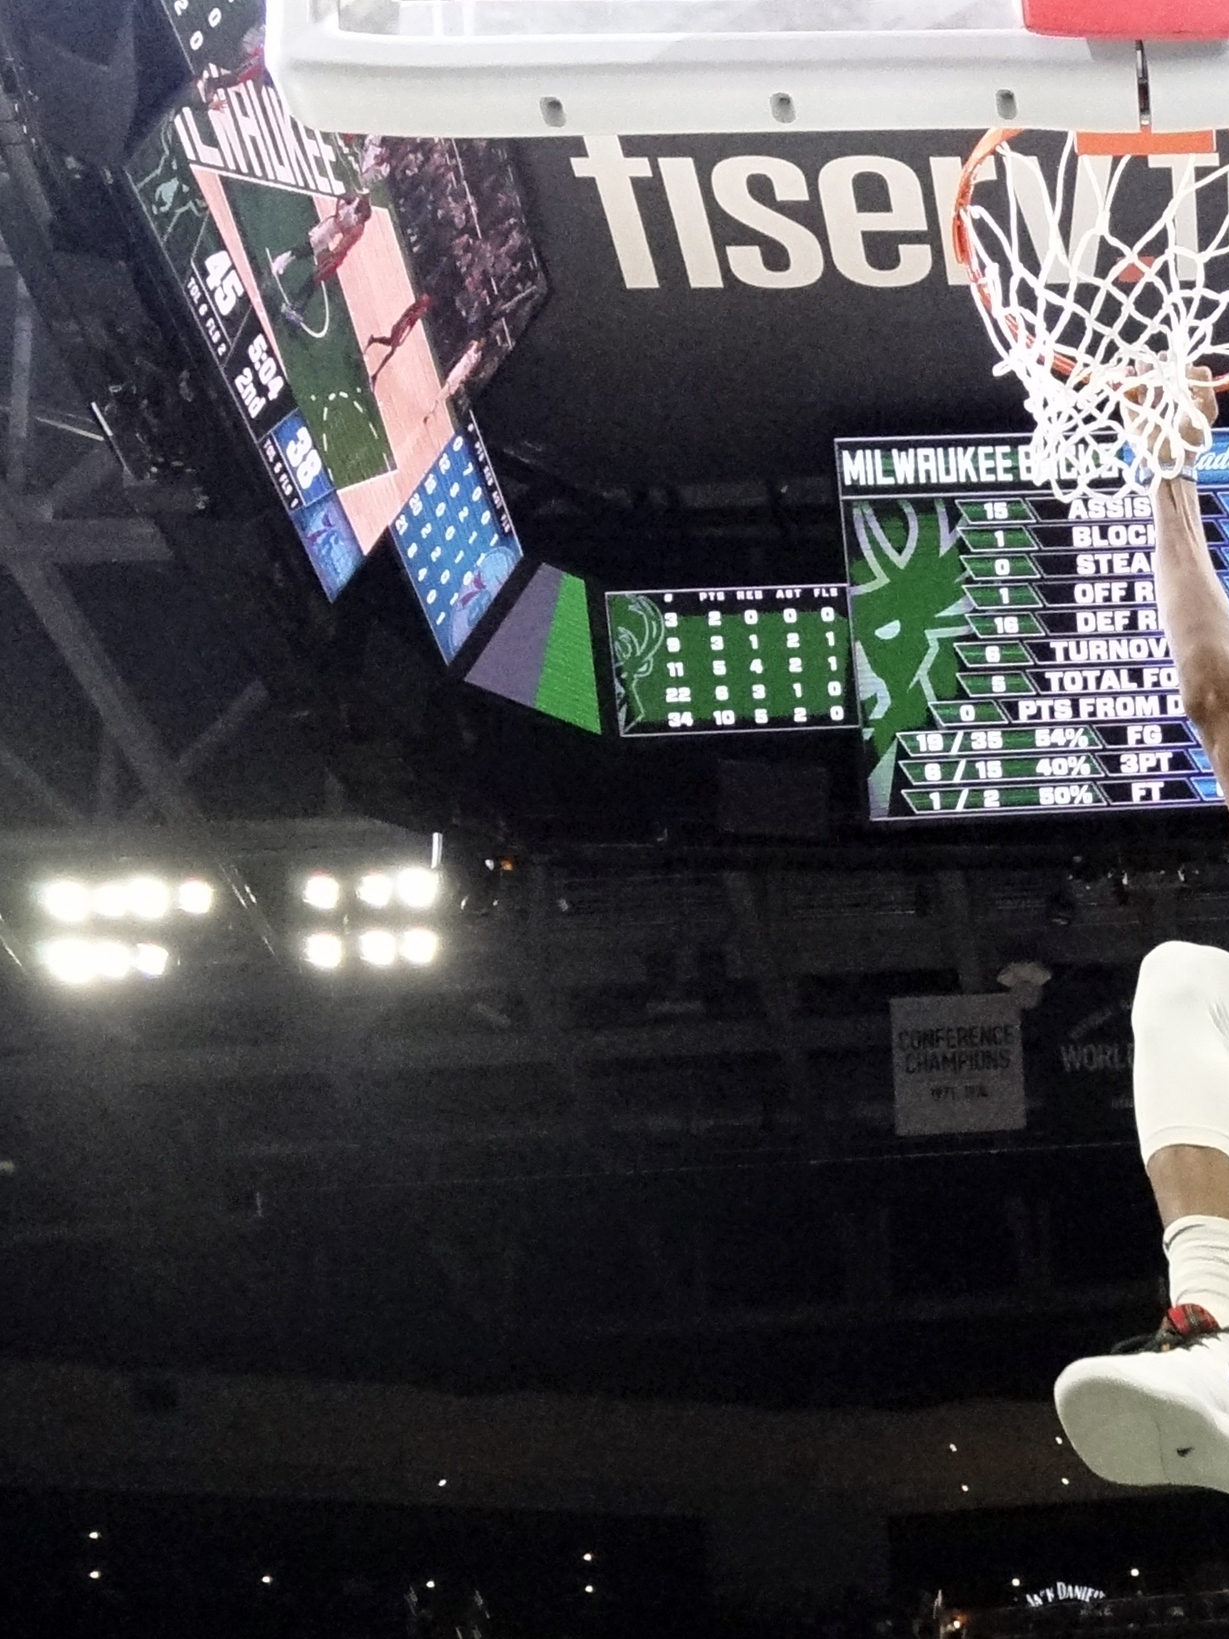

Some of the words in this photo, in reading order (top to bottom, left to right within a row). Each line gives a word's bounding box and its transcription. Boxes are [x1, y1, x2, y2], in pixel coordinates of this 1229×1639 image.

[205, 251, 244, 316] 45
[217, 343, 226, 356] 2
[248, 334, 284, 401] 5:04
[234, 367, 266, 419] 2nd
[286, 427, 322, 489] 38
[842, 445, 1013, 486] MILWAUKEE
[472, 486, 482, 501] 0
[481, 511, 490, 525] 0
[984, 502, 1008, 519] 15
[1068, 500, 1152, 520] ASSIS
[445, 526, 455, 540] 0
[995, 531, 1004, 547] 1
[1073, 527, 1156, 547] BLOC
[995, 559, 1010, 575] 0
[1077, 554, 1156, 574] STEA
[441, 570, 450, 584] 0
[427, 590, 436, 604] 0
[999, 588, 1009, 604] 1
[1074, 584, 1130, 604] OFF
[665, 613, 678, 627] 3
[708, 611, 721, 626] 2
[744, 610, 758, 624] 0
[783, 608, 797, 623] 0
[821, 607, 834, 622] 0
[1077, 612, 1130, 632] DEF
[711, 636, 724, 650] 3
[749, 635, 758, 649] 1
[787, 633, 800, 647] 2
[826, 631, 835, 646] 1
[1050, 640, 1168, 659] TURNOV
[667, 662, 684, 677] 11
[713, 660, 726, 675] 5
[750, 659, 763, 673] 4
[789, 658, 802, 672] 2
[828, 656, 837, 671] 1
[666, 687, 691, 702] 22
[752, 684, 765, 699] 3
[793, 683, 802, 697] 1
[828, 681, 841, 696] 0
[992, 676, 1006, 692] 5
[1045, 671, 1138, 691] TOTAL
[668, 712, 693, 727] 34
[713, 710, 735, 725] 10
[755, 709, 768, 723] 5
[794, 707, 807, 722] 2
[830, 706, 844, 720] 0
[960, 705, 975, 721] 0
[1018, 701, 1075, 721] PTS
[1080, 699, 1160, 718] FROM
[917, 734, 943, 751] 19
[971, 732, 1002, 750] 35
[1035, 728, 1088, 749] 54%
[1127, 725, 1162, 745] FG
[975, 762, 1001, 778] 15
[1036, 756, 1091, 776] 40%
[1120, 752, 1172, 773] 3PT
[929, 792, 940, 809] 1
[984, 790, 999, 807] 2
[1039, 785, 1092, 805] 50%
[1131, 782, 1164, 802] FT
